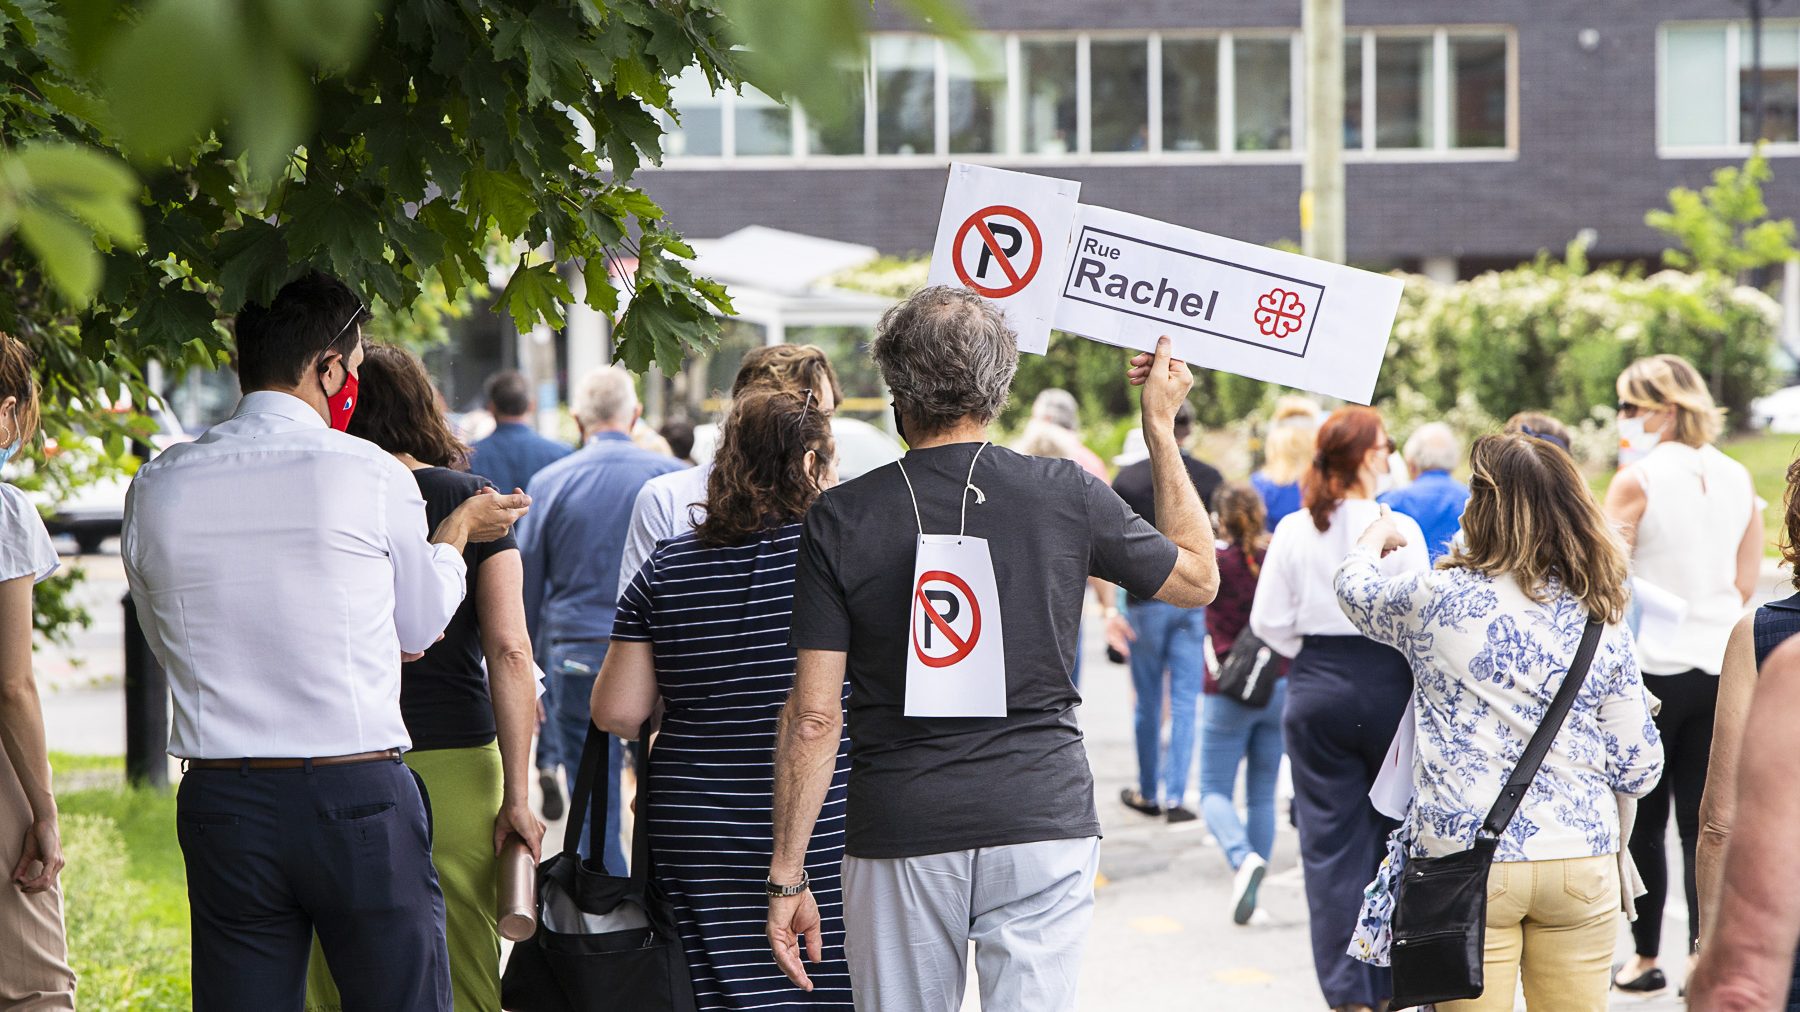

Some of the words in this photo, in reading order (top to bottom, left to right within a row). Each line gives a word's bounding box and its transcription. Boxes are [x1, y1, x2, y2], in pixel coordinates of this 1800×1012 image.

[975, 221, 1023, 279] P
[1083, 237, 1121, 260] Rue
[1074, 257, 1219, 322] Rachel
[924, 589, 960, 649] P
